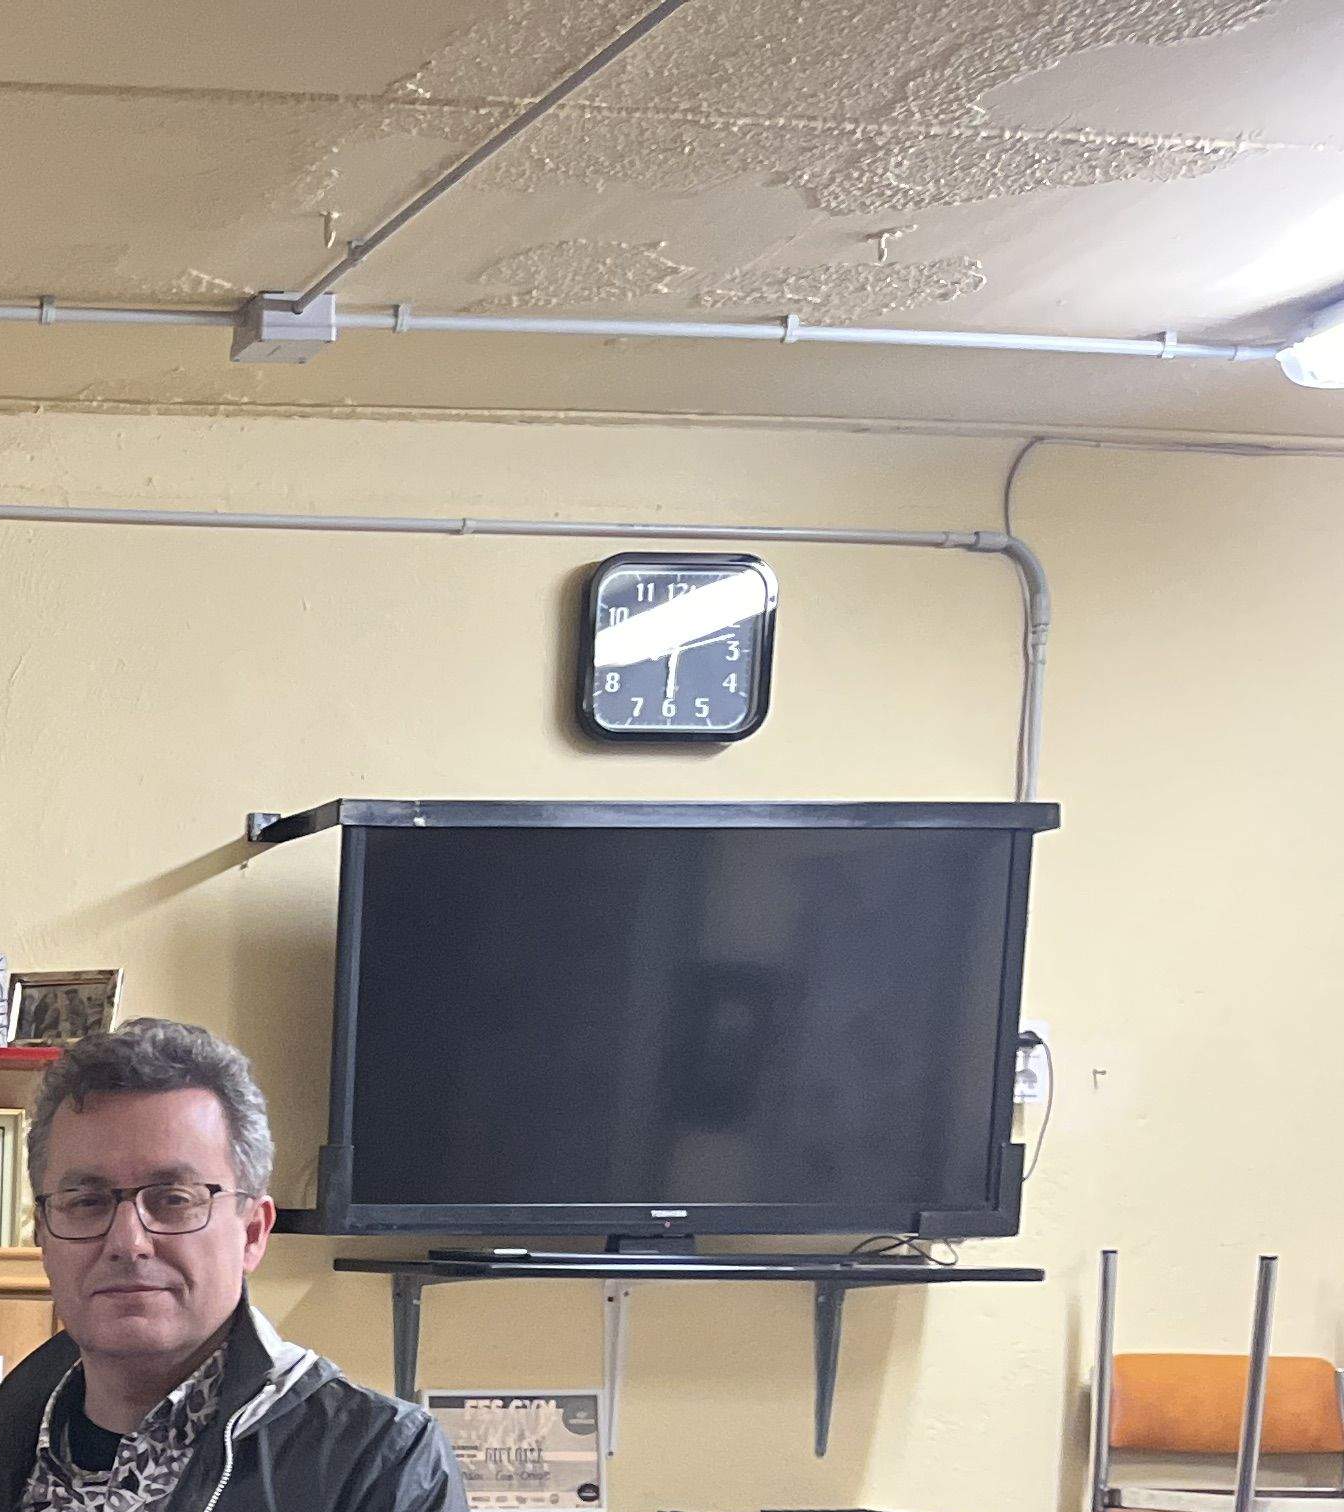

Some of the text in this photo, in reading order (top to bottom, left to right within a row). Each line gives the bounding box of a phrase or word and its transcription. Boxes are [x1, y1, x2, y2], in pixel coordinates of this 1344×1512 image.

[637, 583, 655, 602] 11
[726, 641, 740, 661] 3
[605, 672, 620, 692] 8
[722, 673, 737, 693] 4
[631, 698, 644, 717] 7
[662, 699, 676, 718] 6
[695, 698, 709, 718] 5
